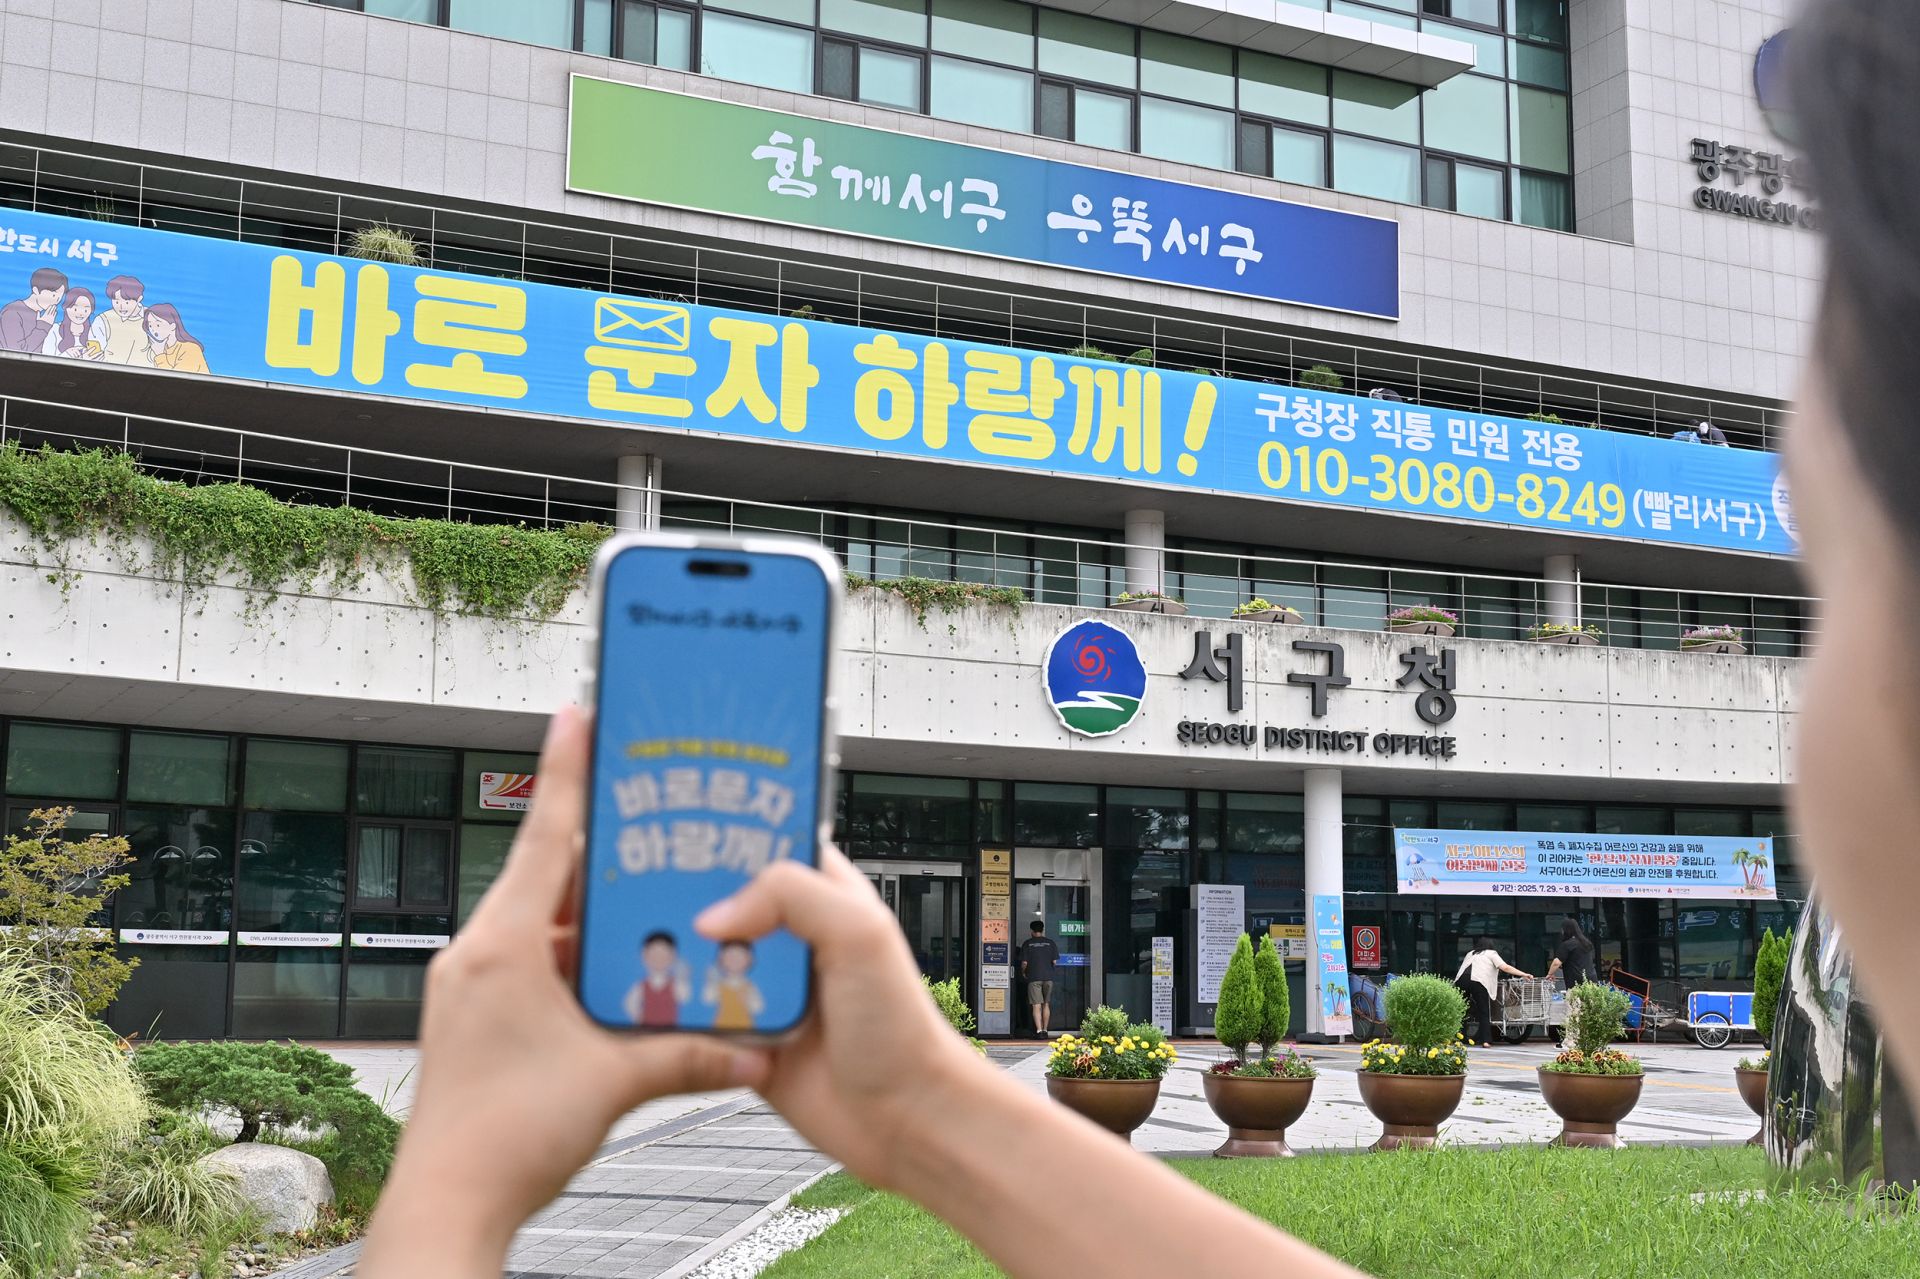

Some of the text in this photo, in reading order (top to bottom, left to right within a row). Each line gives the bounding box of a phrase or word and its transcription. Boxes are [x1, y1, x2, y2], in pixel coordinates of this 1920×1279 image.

[752, 130, 1263, 275] 함께서구 우뚝서구
[1693, 186, 1797, 224] GWANGJU
[66, 239, 119, 267] 서구
[265, 255, 1217, 477] 바로 문자 하랑께!
[1255, 392, 1583, 471] 구청장 직통 민원 전용
[1257, 441, 1625, 528] 010-3080-8249
[1632, 487, 1766, 541] (빨리서구)
[1178, 631, 1457, 725] 서구청
[1177, 720, 1457, 758] SEOGU DISTRICT OFFICE
[1446, 844, 1471, 858] 서구
[1537, 840, 1555, 850] 폭염
[1557, 841, 1566, 850] 속
[1604, 842, 1638, 852] 어르신의
[1640, 843, 1666, 852] 건강과
[1687, 844, 1704, 853] 위해
[1538, 853, 1547, 863] 이
[1549, 854, 1583, 864] 리어카는
[1681, 856, 1716, 866] 중입니다.
[1539, 866, 1591, 876] 서구아너스가
[1593, 867, 1627, 877] 어르신의
[1648, 868, 1673, 878] 안전을
[1675, 869, 1719, 879] 후원합니다.
